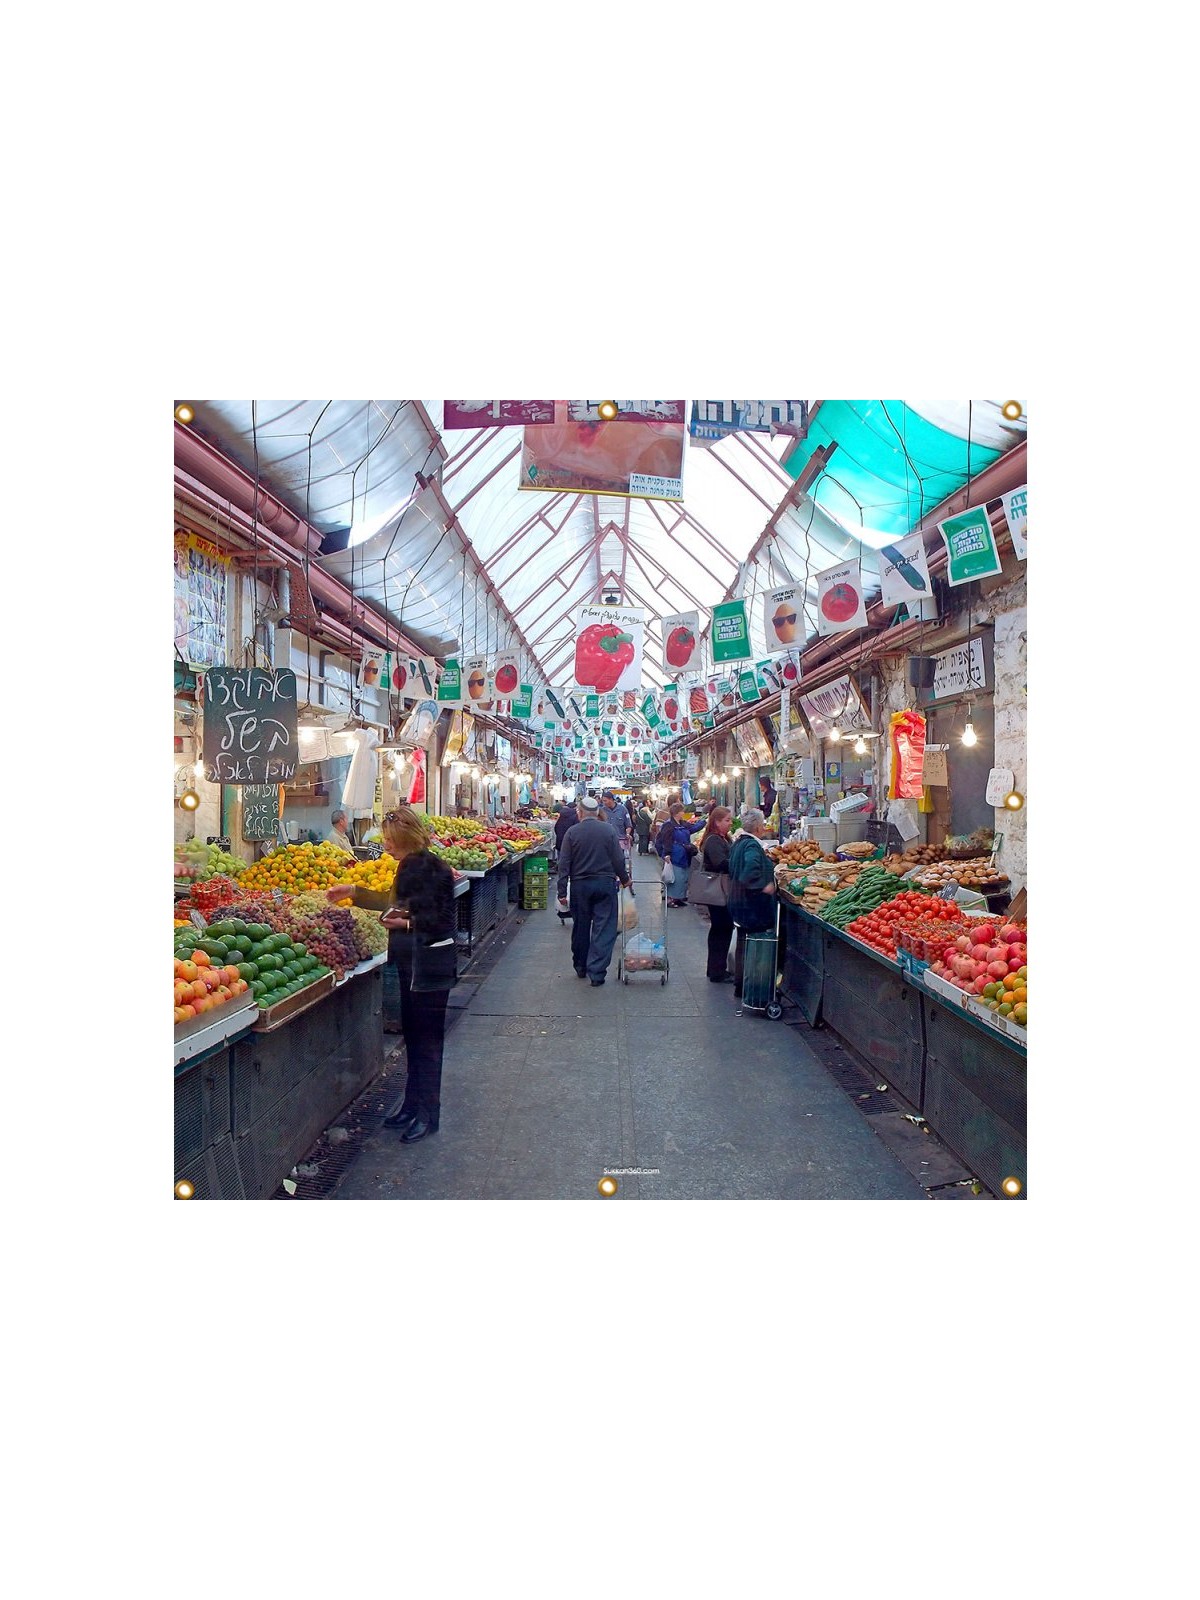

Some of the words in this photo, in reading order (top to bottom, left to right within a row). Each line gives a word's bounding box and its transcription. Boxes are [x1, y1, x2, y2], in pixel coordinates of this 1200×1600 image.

[206, 670, 293, 709] אבוקדו
[221, 709, 290, 753] בשל
[264, 760, 296, 784] מוכן
